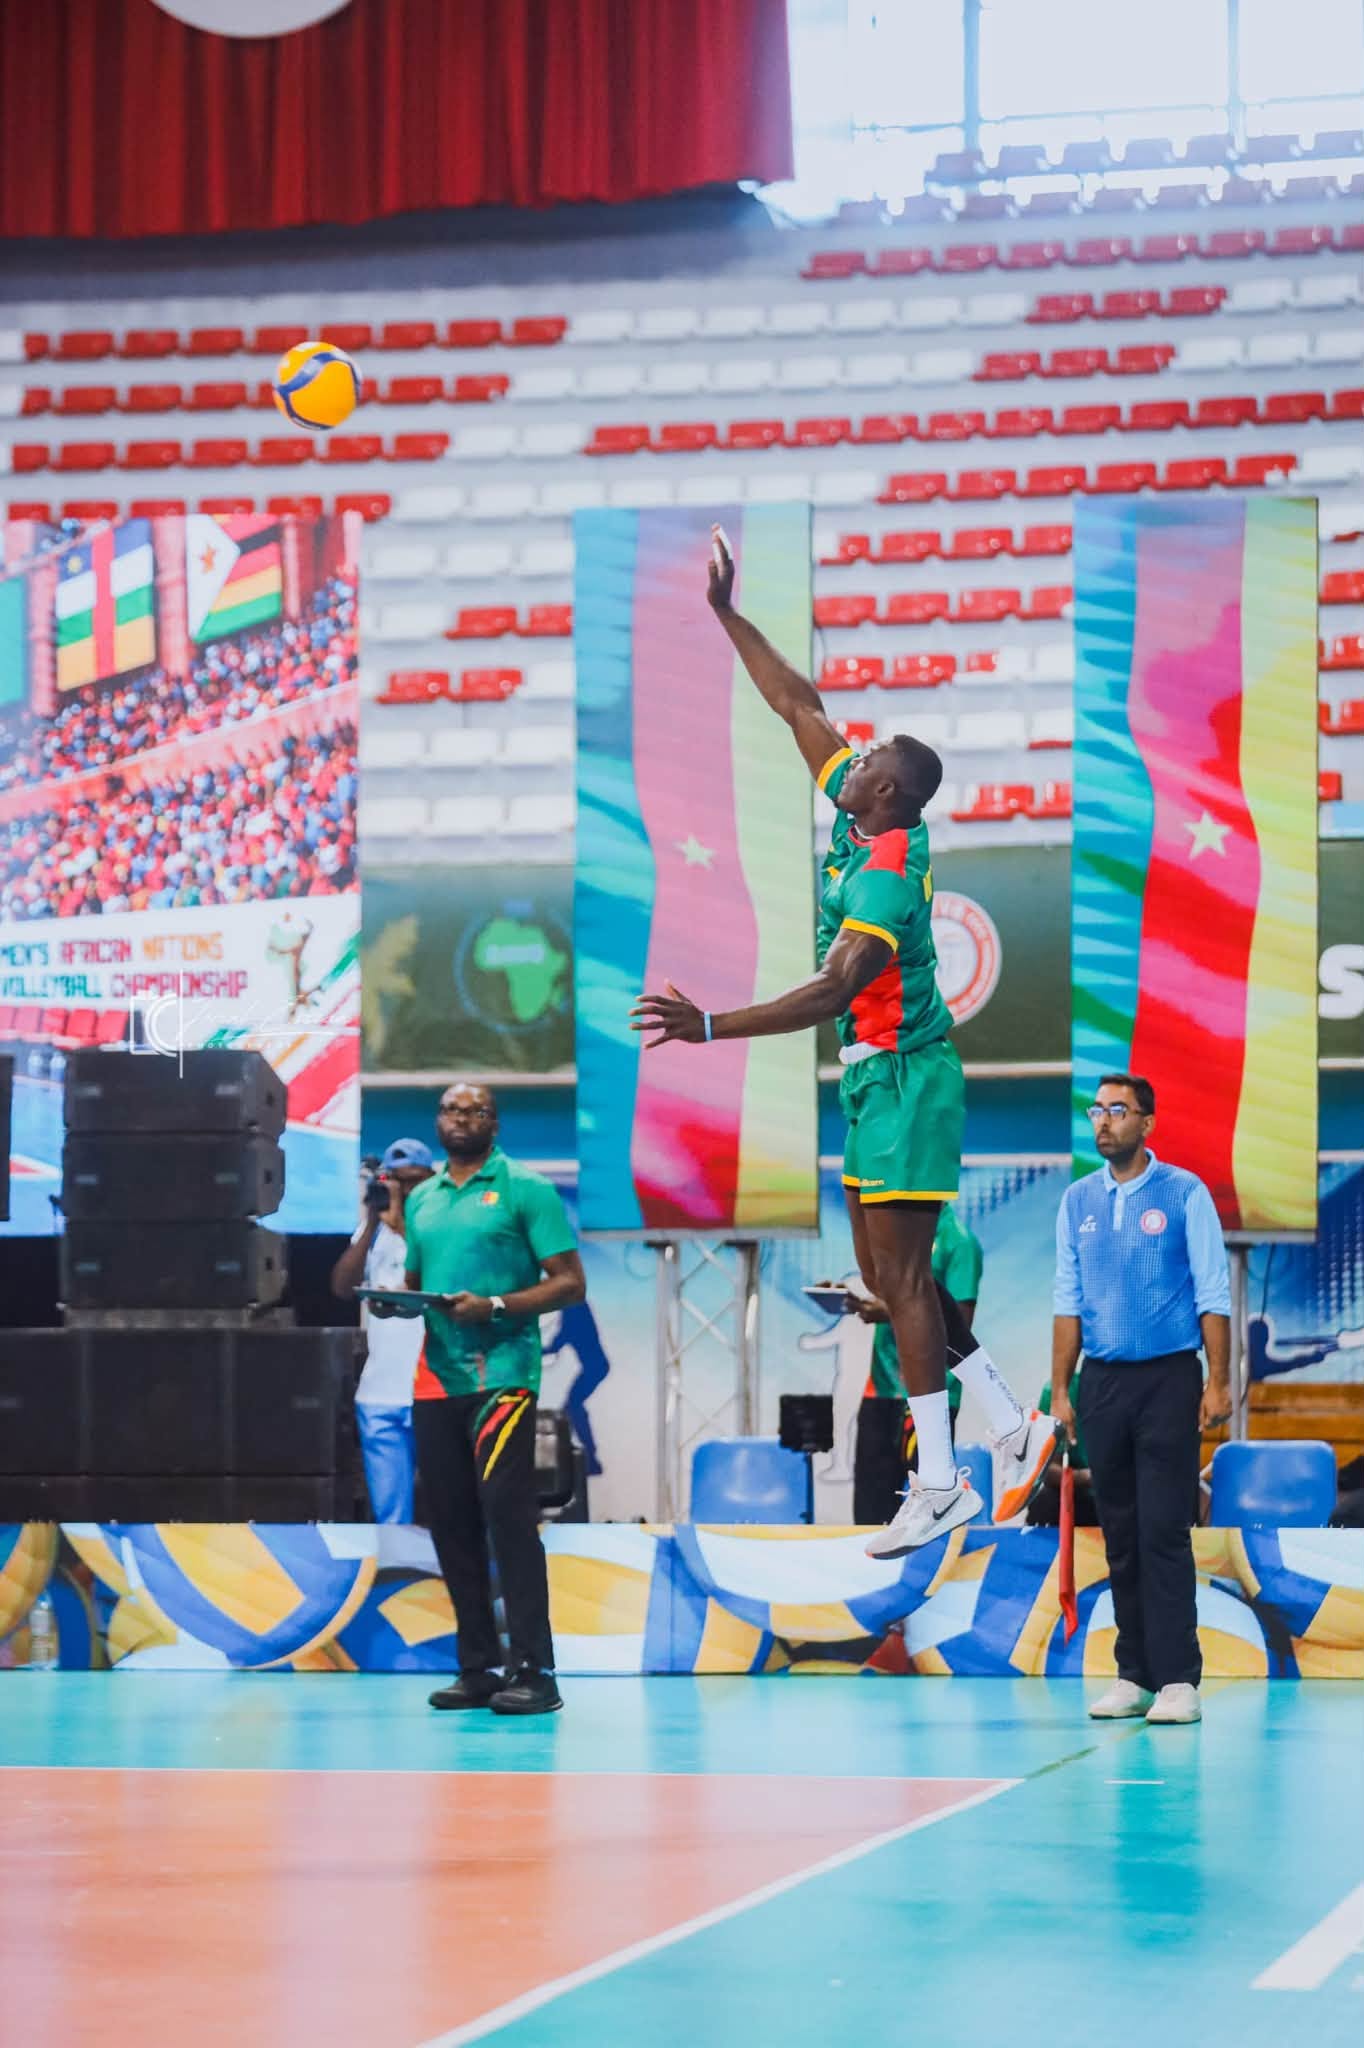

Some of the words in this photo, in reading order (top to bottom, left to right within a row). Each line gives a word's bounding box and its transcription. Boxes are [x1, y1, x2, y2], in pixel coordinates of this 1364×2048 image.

[61, 938, 131, 965] AFRICAN
[142, 931, 224, 961] NATIONS
[2, 975, 102, 998] VOLLEYBALL
[111, 970, 248, 998] CHAMPIONSHIP
